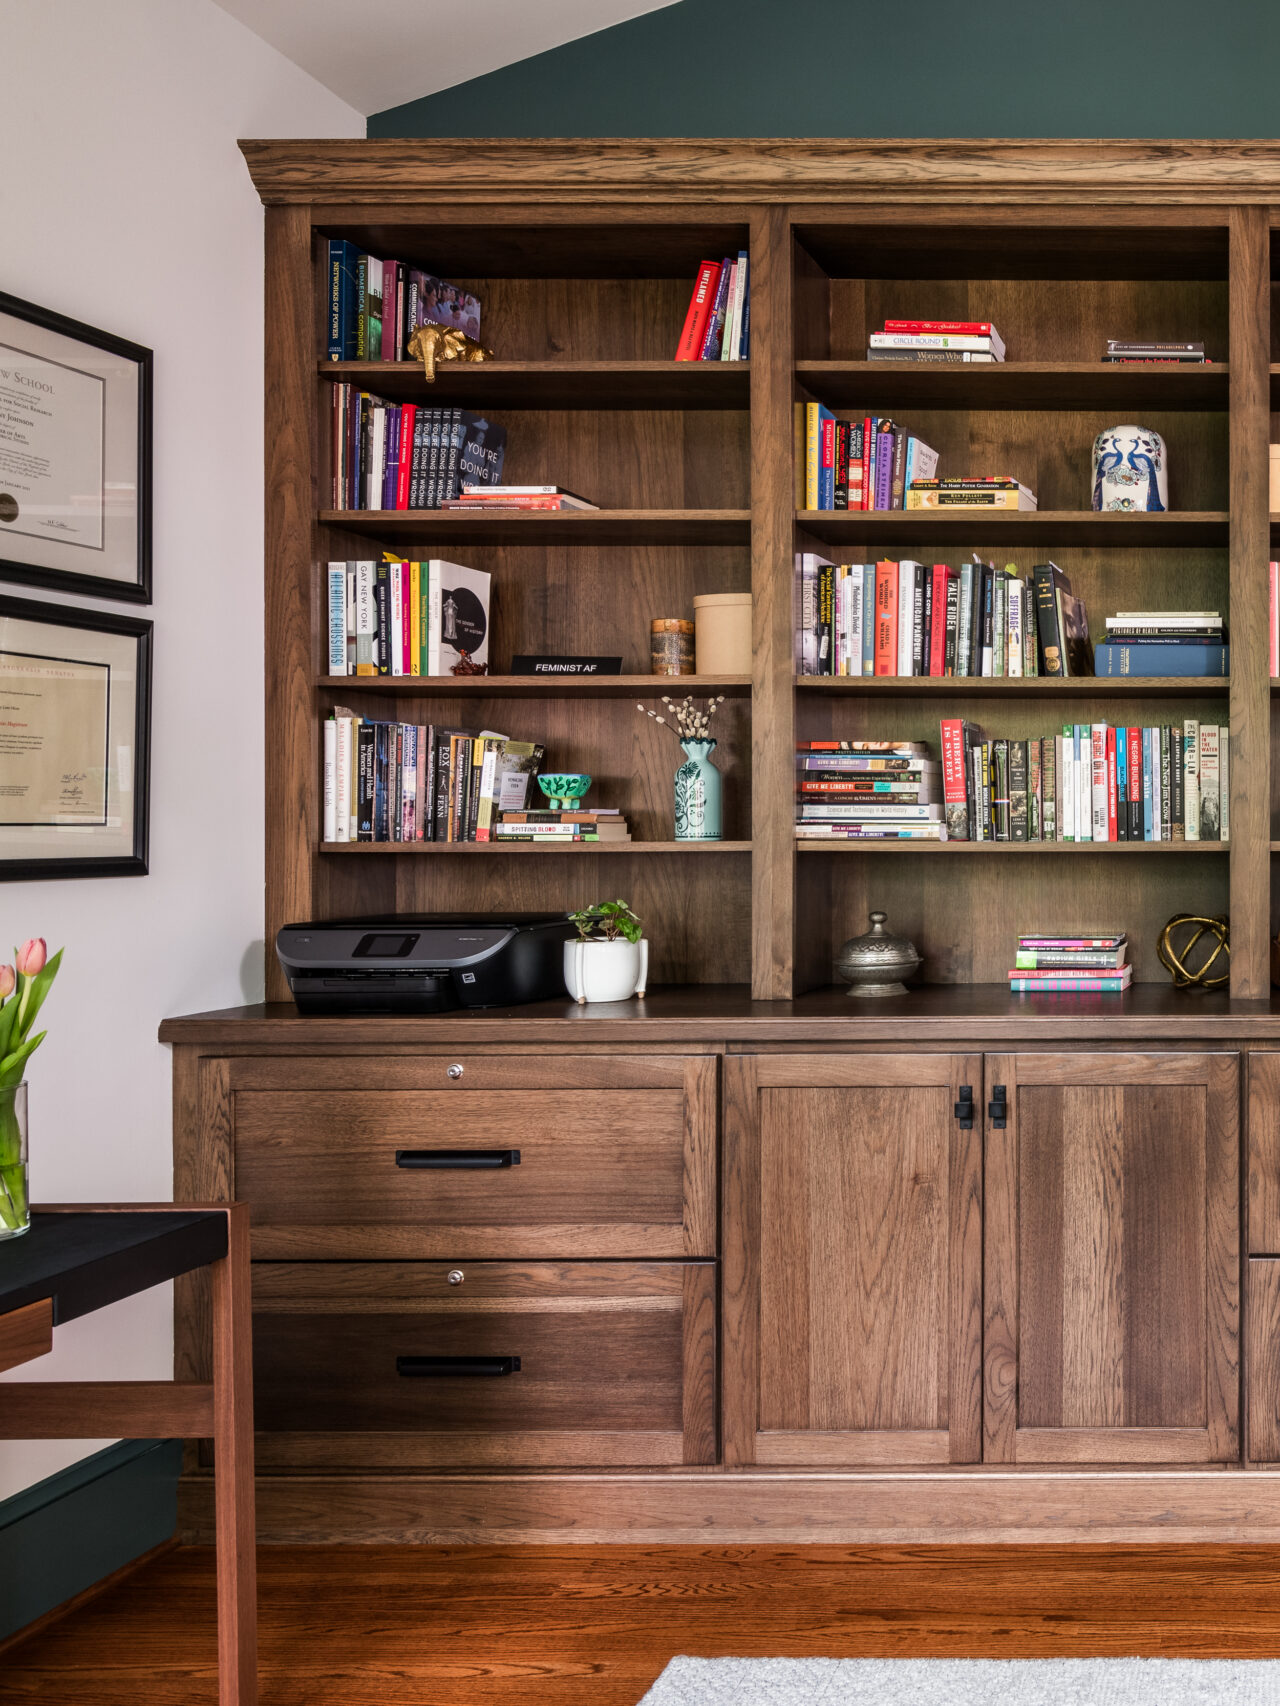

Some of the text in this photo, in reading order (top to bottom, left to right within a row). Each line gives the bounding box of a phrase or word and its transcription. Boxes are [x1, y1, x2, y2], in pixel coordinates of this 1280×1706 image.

[696, 270, 711, 303] INFLAMED
[332, 302, 339, 313] OF
[357, 315, 365, 356] computing
[917, 351, 945, 359] Women
[432, 423, 440, 446] YOU'RE
[440, 423, 449, 446] YOU'RE
[451, 423, 459, 446] YOU'RE
[420, 448, 428, 470] DOING
[429, 448, 437, 470] DOING
[448, 448, 456, 470] DOING
[467, 441, 498, 464] YOU'RE
[460, 458, 499, 483] DOING IT
[360, 585, 368, 605] NEW
[804, 583, 813, 626] FIRST CITY
[947, 582, 957, 631] PALE RIDER
[330, 574, 344, 664] ATLANTIC CROSSINGS
[360, 608, 368, 630] YORK
[913, 587, 922, 660] AMERICAN PANDEMIC
[1009, 595, 1019, 629] SUFFRAGE
[535, 663, 598, 672] FEMINIST AF
[944, 727, 953, 782] IS SWEET
[952, 729, 962, 779] LIBERTY
[1043, 739, 1055, 768] BLACK
[1093, 731, 1104, 786] AMERICA ON FIRE
[1187, 730, 1196, 775] COLOR LAW
[325, 779, 331, 787] to
[1161, 786, 1169, 798] Jim
[1030, 981, 1102, 990] ALL IN HER HEAD
